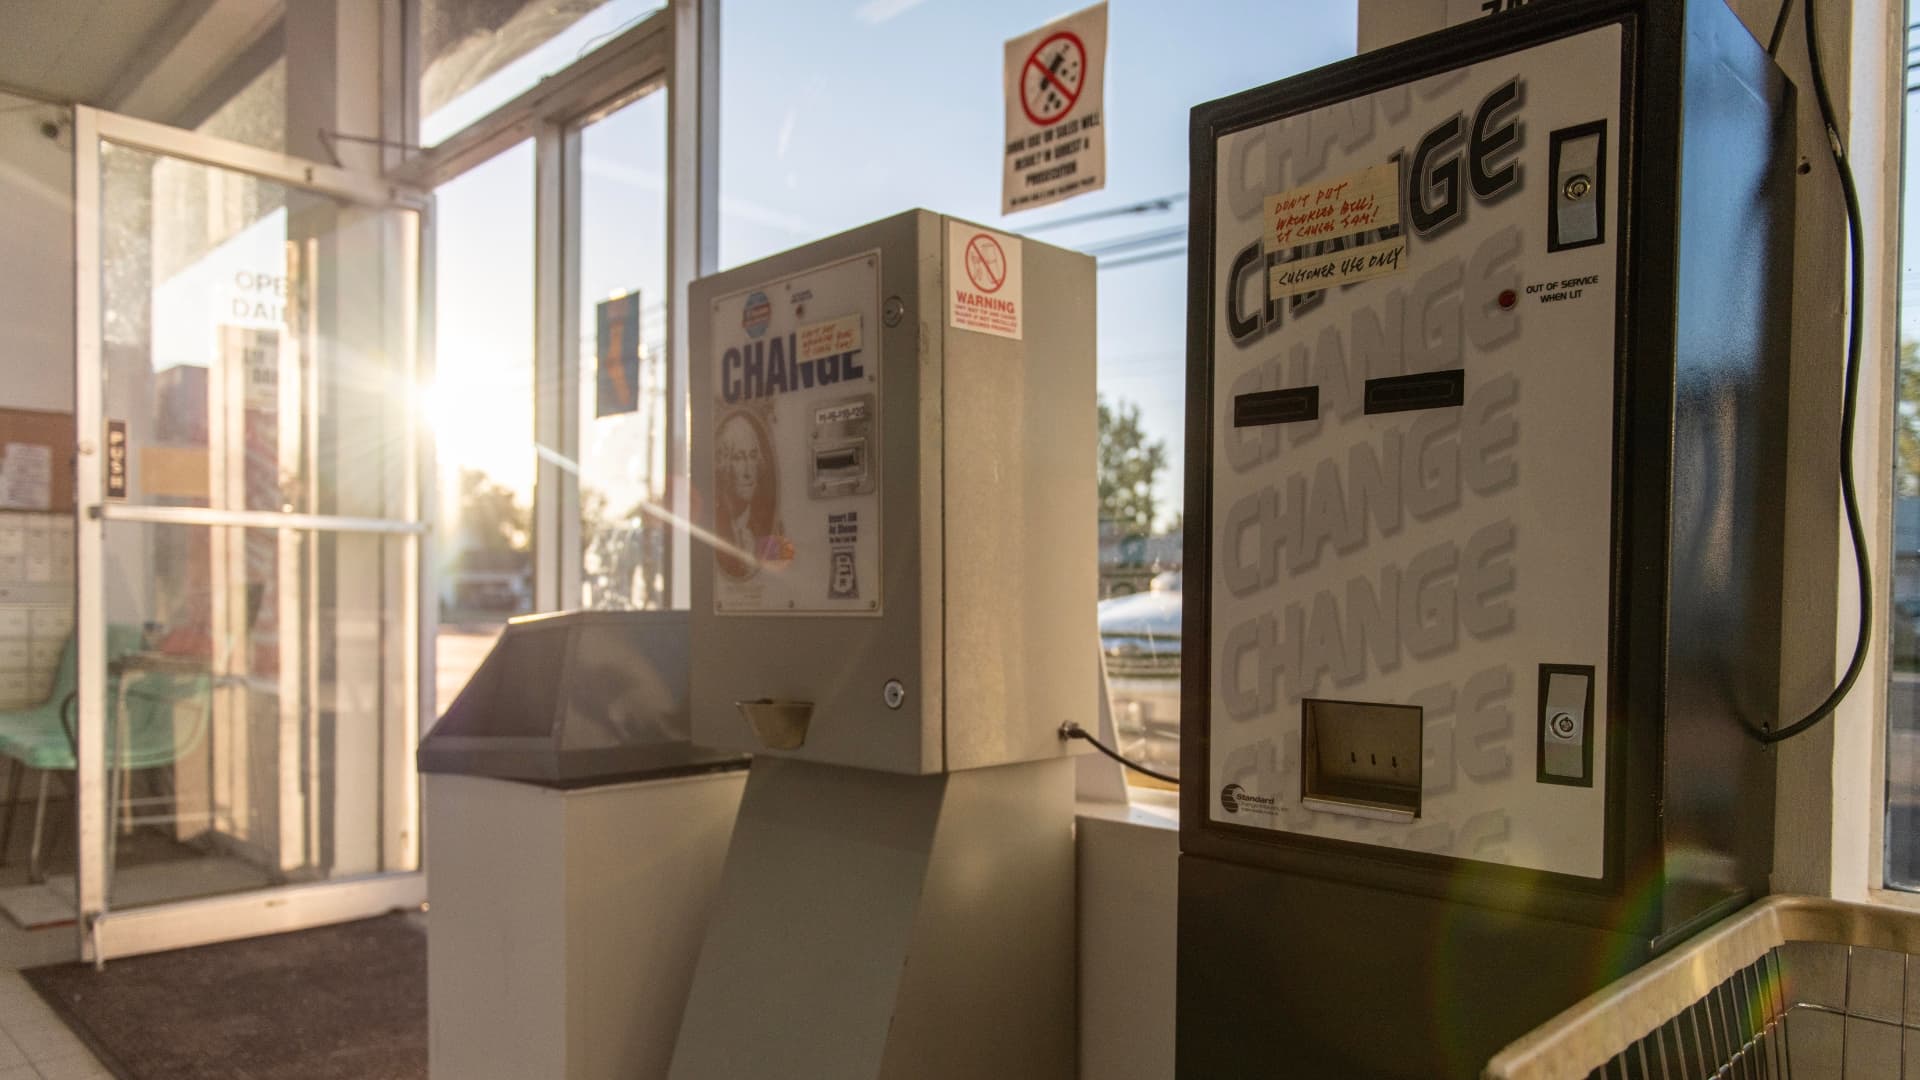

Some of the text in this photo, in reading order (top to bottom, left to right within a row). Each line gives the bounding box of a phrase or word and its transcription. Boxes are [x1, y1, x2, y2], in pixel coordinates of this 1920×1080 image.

[1275, 181, 1348, 215] DON'T PUT
[1341, 204, 1380, 229] JAM!
[1278, 246, 1404, 285] CUSTOMER USE ONLY
[1526, 275, 1599, 294] OUT OF SERVICE
[1540, 289, 1583, 303] WHEN LIT
[956, 289, 1016, 314] WARNING
[1222, 371, 1520, 598] CHANGE
[1221, 517, 1517, 723] CHANGE
[1236, 793, 1275, 805] Standard
